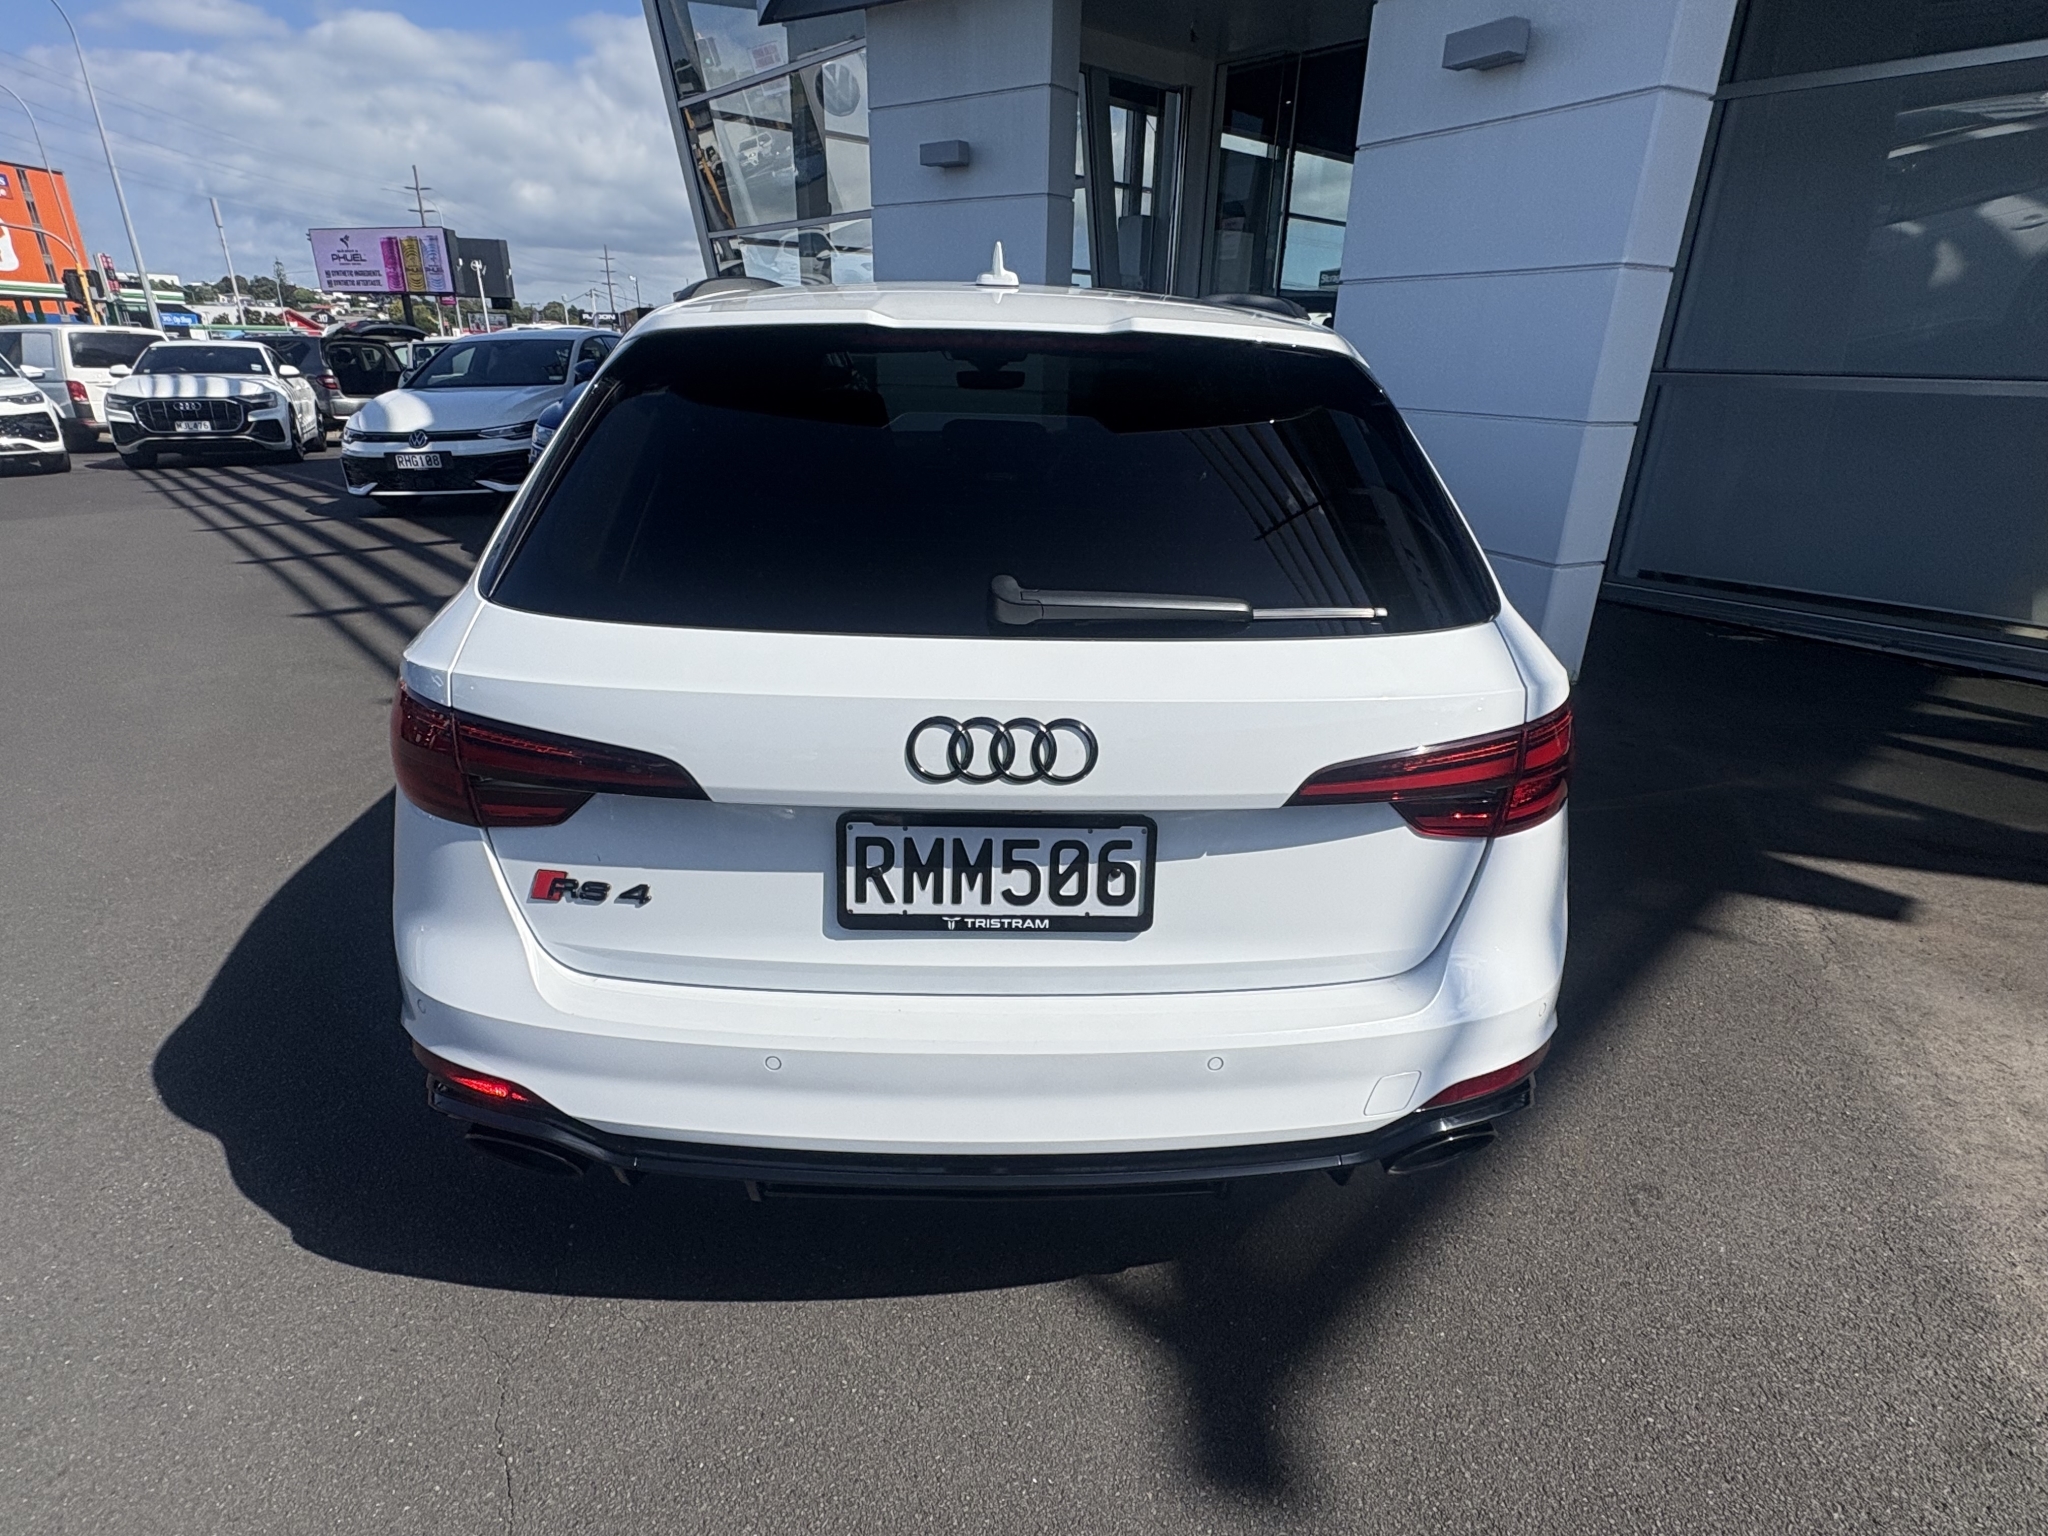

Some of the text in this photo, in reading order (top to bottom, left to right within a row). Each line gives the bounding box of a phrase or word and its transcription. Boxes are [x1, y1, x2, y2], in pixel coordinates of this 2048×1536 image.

[331, 253, 367, 262] PHUEL
[854, 836, 1137, 906] RMM506
[617, 883, 653, 905] 4
[964, 918, 1050, 929] TRISTRAM
